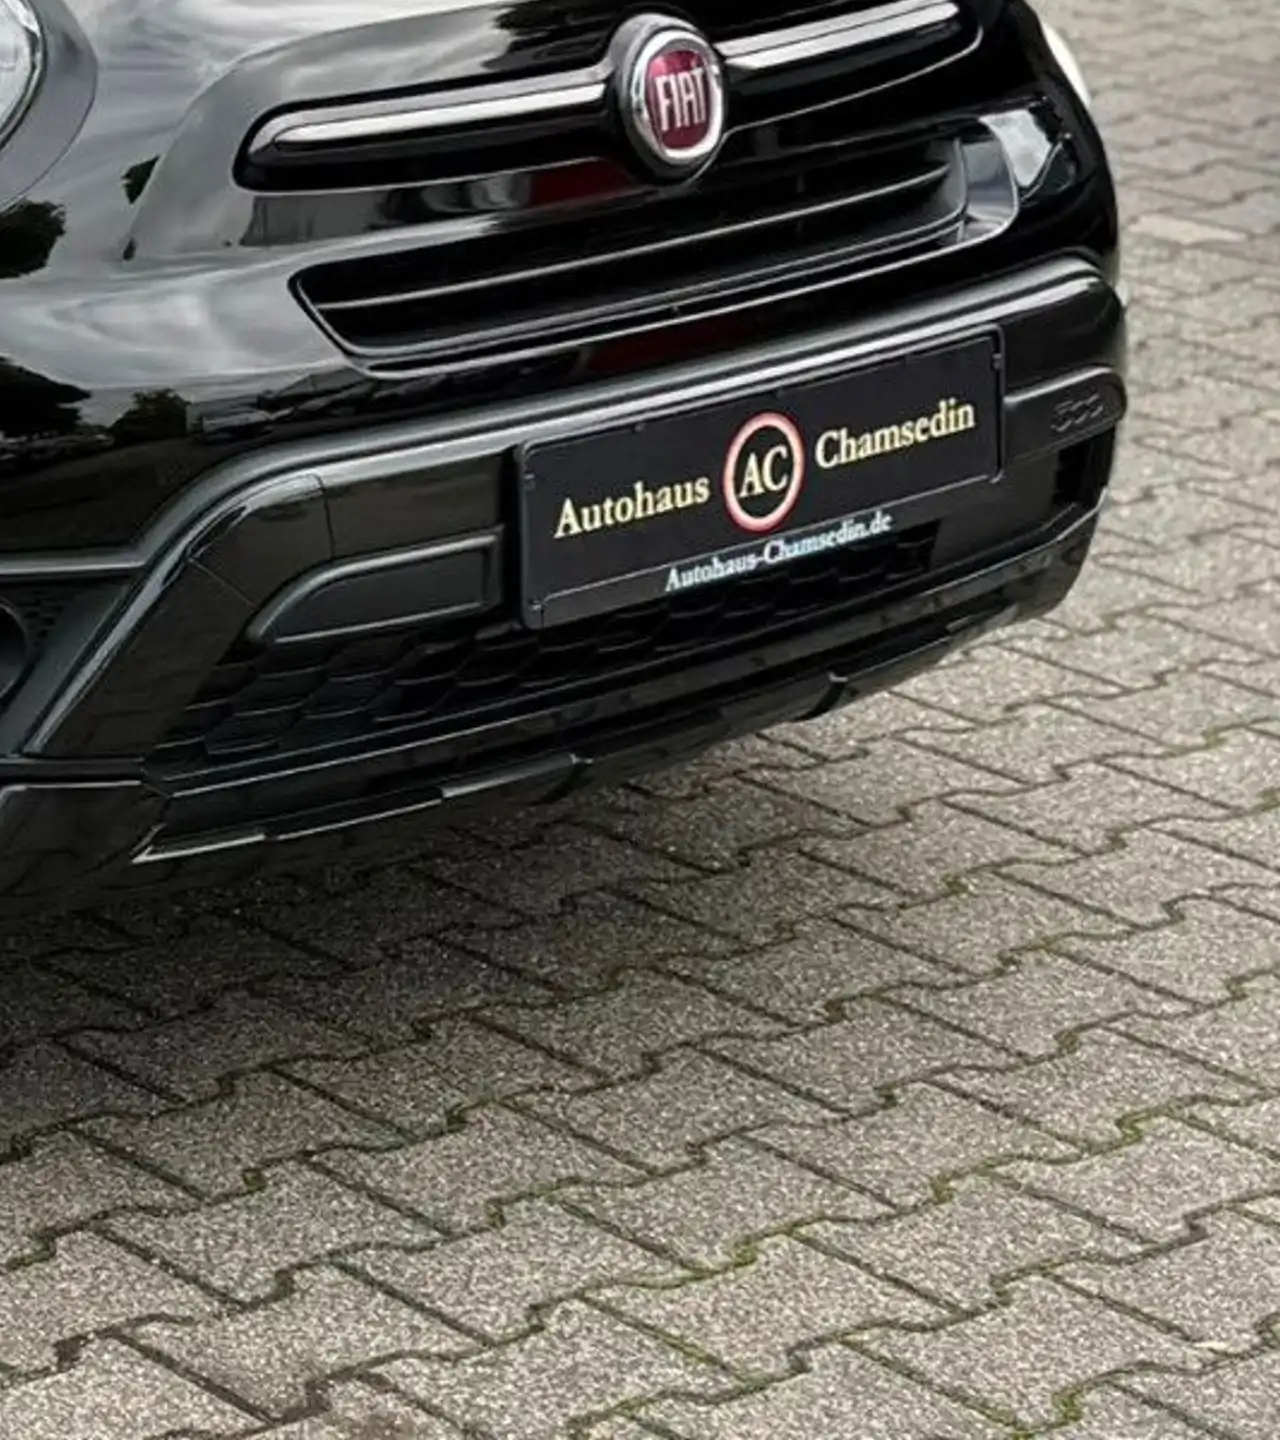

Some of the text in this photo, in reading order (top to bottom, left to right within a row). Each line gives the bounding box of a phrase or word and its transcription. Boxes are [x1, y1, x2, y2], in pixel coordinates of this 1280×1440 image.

[655, 67, 706, 131] FIAT
[555, 398, 976, 539] Autohaus AC Chamsedin
[664, 512, 893, 593] Autohaus-Chamsedin.de
